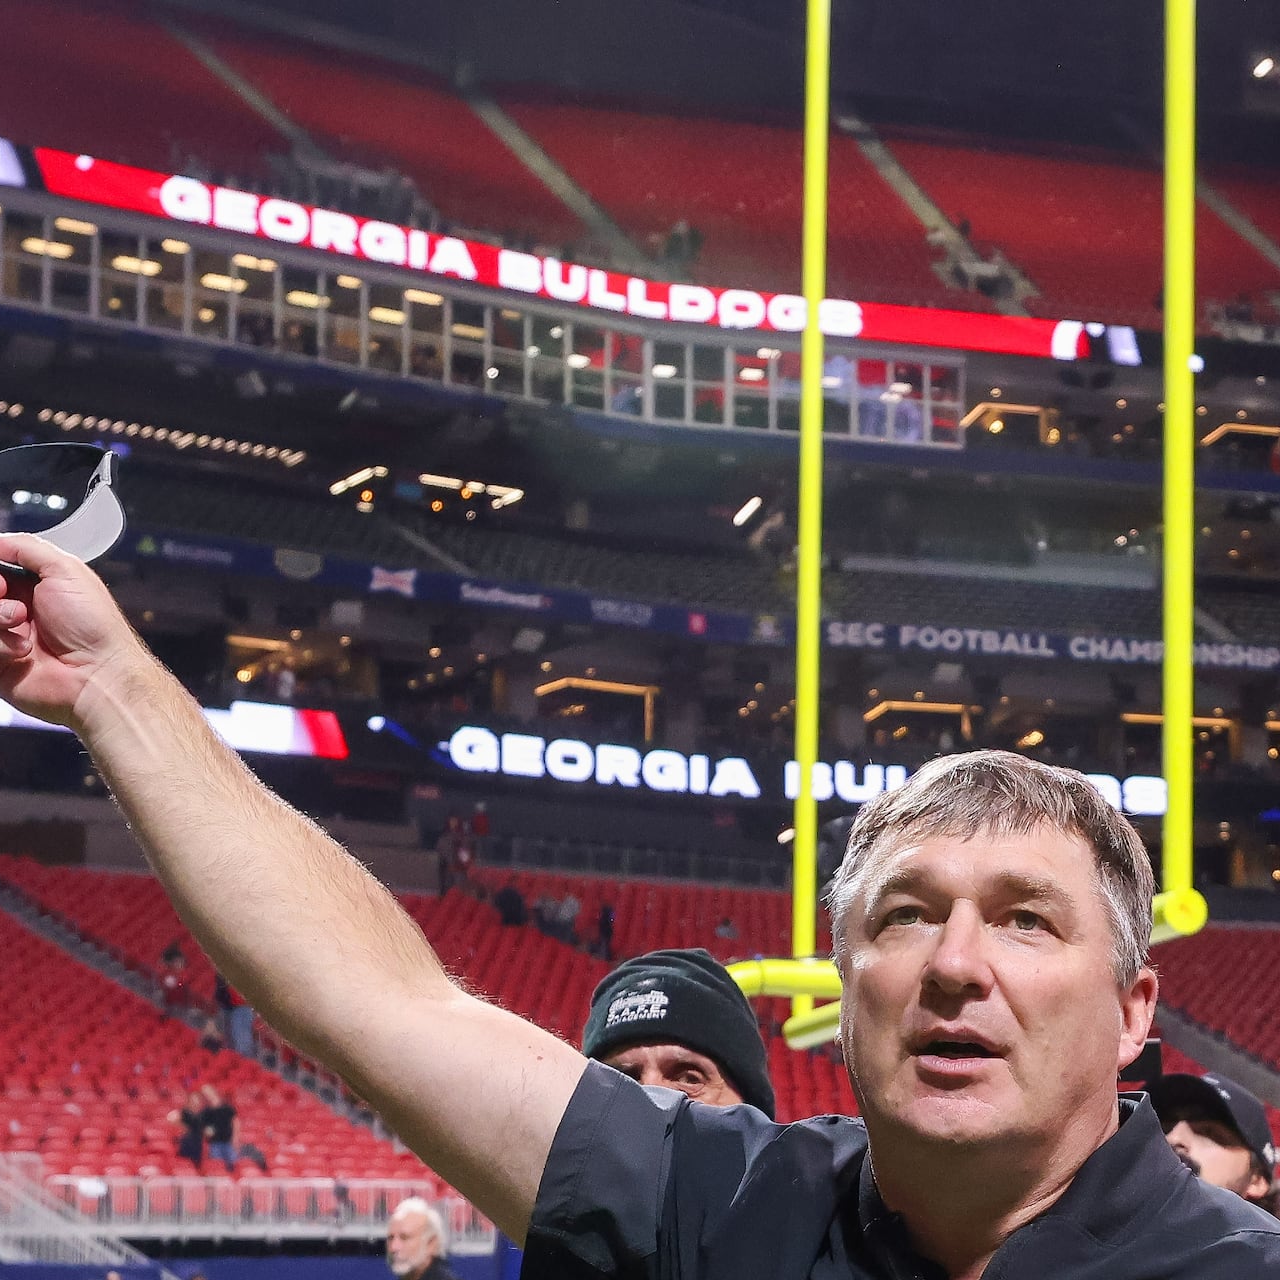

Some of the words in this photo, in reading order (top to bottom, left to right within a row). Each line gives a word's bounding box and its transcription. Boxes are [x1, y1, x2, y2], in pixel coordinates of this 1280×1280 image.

[159, 175, 477, 280] GEORGIA
[498, 249, 863, 338] BULLDOGS
[828, 622, 885, 647] SEC
[900, 625, 1055, 658] FOOTBALL
[448, 725, 761, 799] GEORGIA
